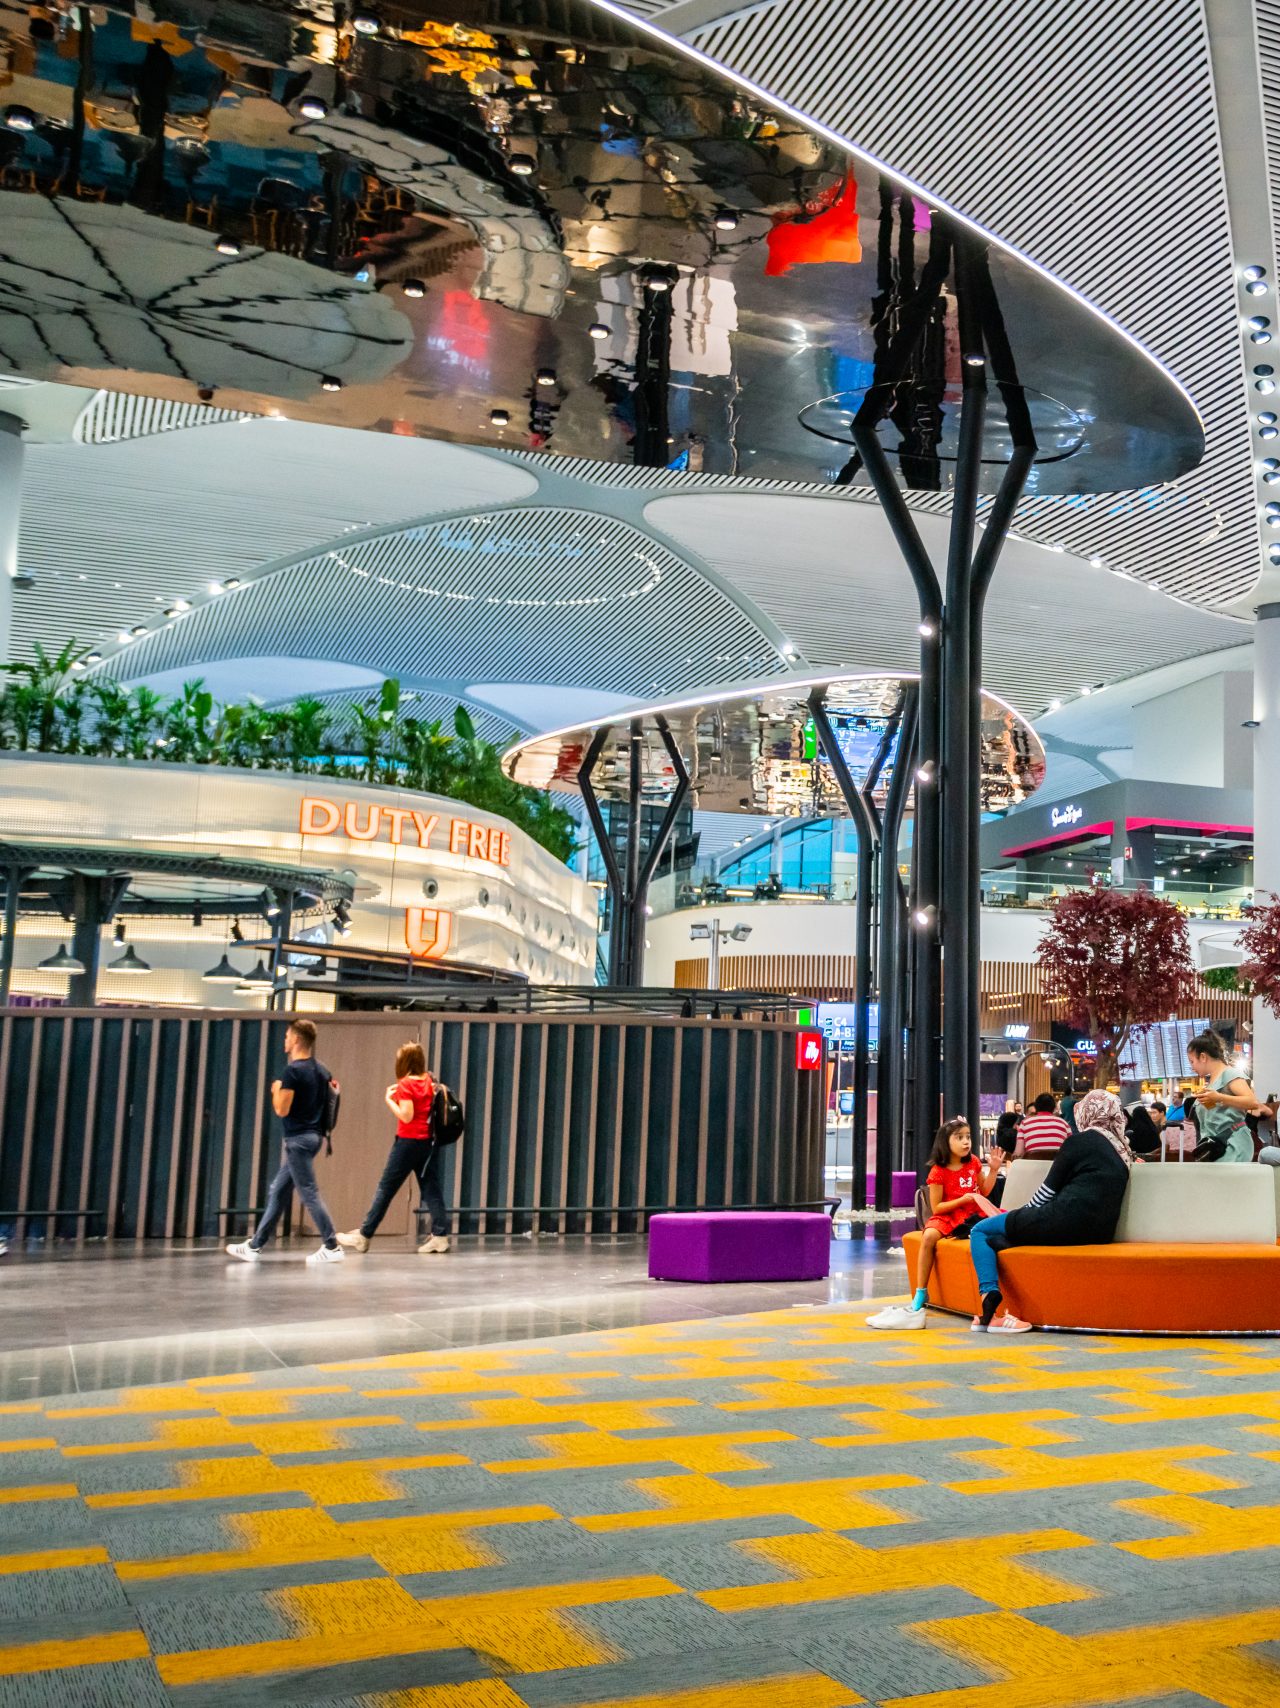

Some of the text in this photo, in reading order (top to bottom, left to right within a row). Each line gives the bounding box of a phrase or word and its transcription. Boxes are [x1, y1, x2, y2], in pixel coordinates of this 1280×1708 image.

[301, 798, 512, 866] DUTY FREE
[834, 1016, 847, 1027] C4
